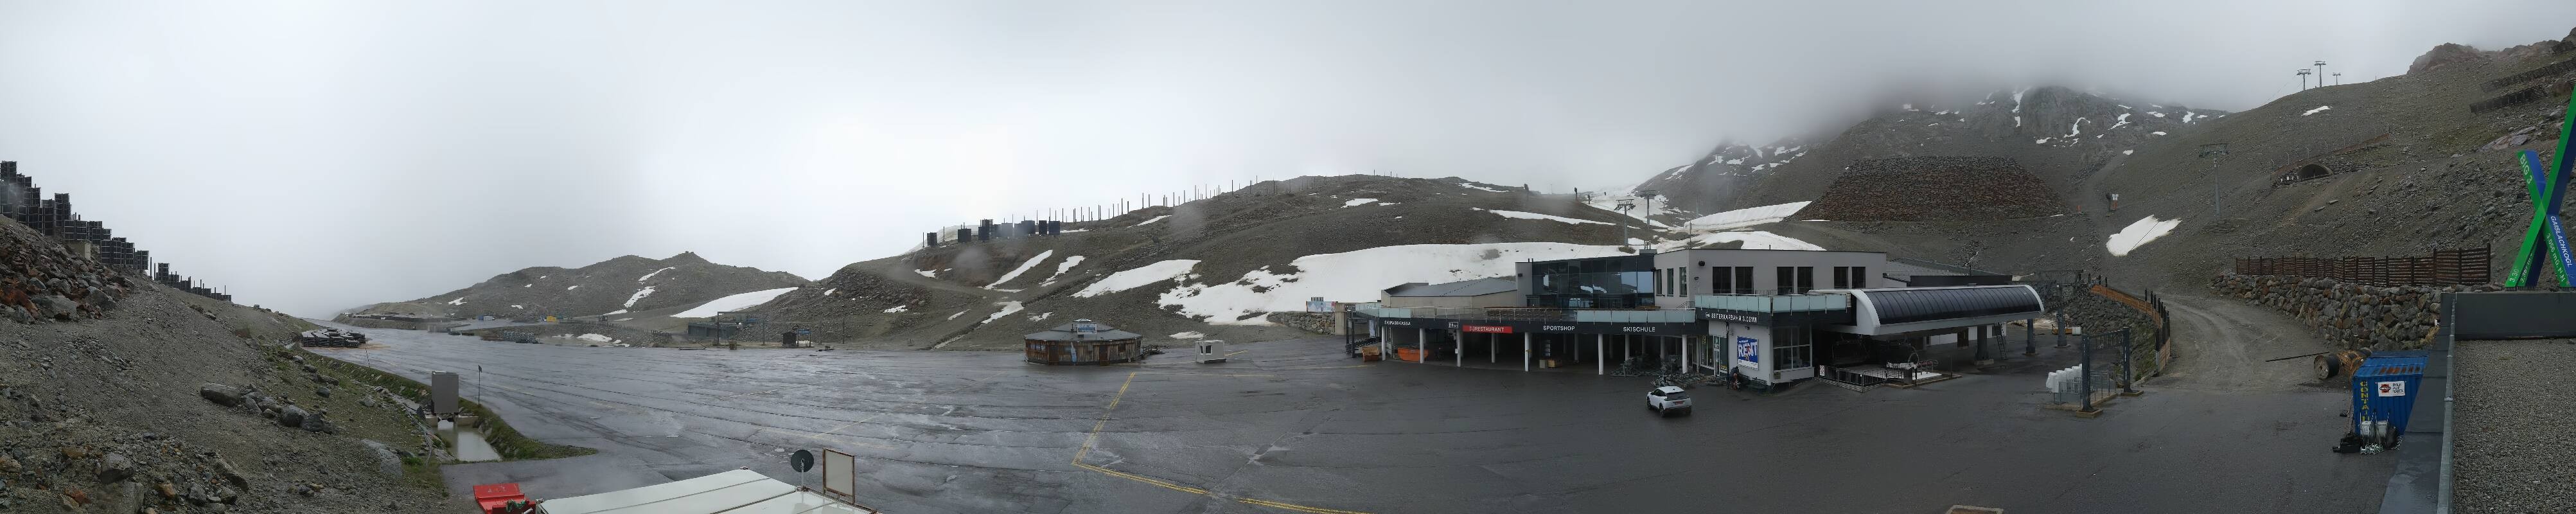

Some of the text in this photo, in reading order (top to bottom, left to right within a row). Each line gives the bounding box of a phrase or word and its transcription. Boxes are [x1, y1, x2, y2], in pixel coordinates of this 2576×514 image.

[2519, 154, 2533, 184] BIG 3
[2550, 216, 2573, 268] GAISLACHKOGL
